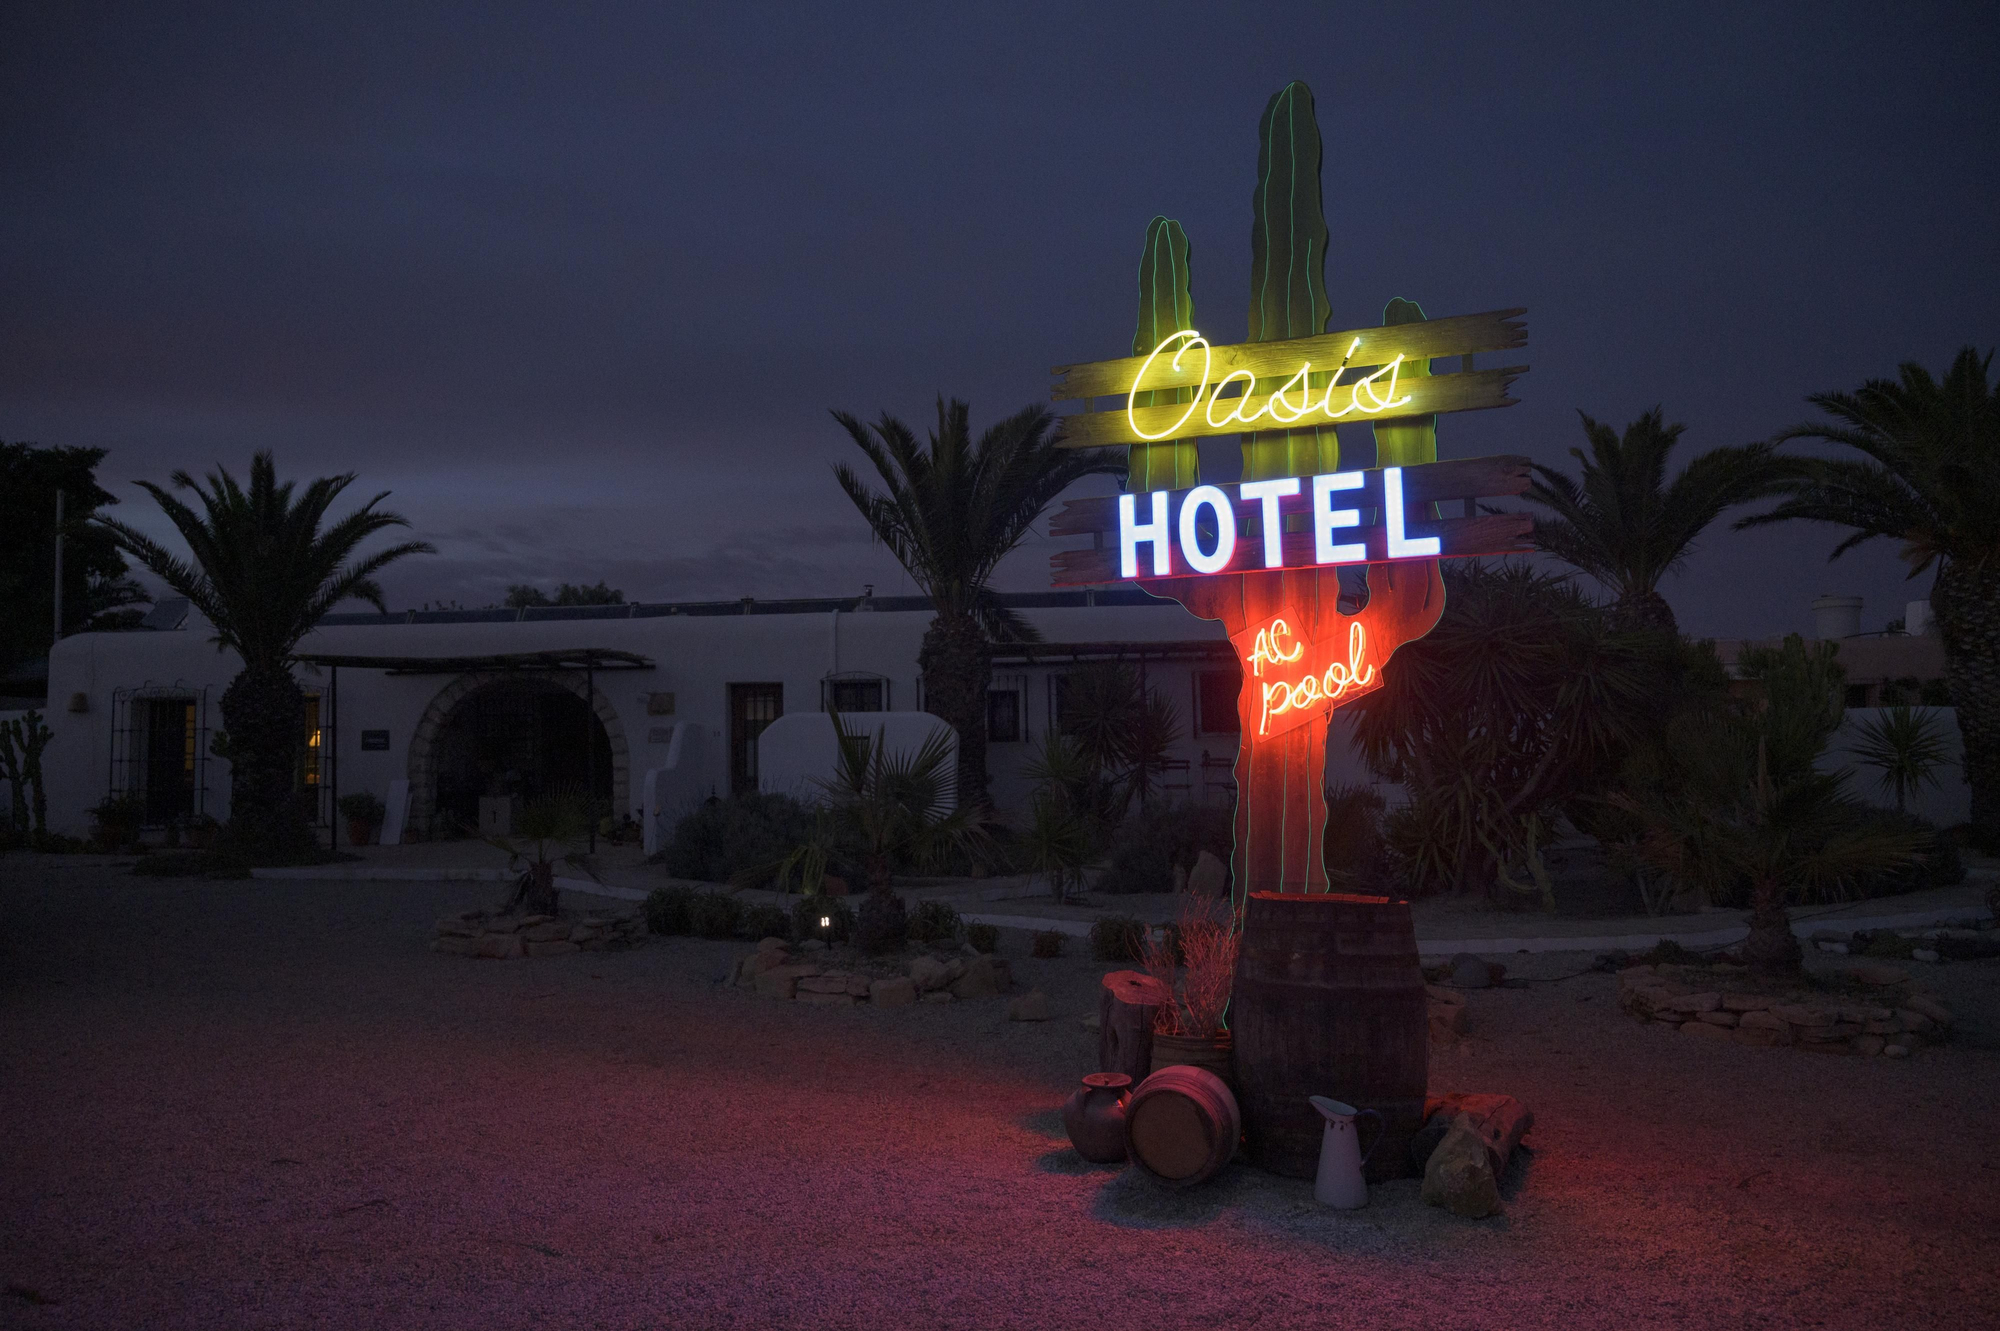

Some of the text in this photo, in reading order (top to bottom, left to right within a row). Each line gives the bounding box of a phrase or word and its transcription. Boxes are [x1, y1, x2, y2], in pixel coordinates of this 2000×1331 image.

[1128, 330, 1411, 440] Oasis
[1119, 467, 1441, 578] HOTEL
[1247, 619, 1302, 676] AC
[1259, 621, 1375, 736] pool
